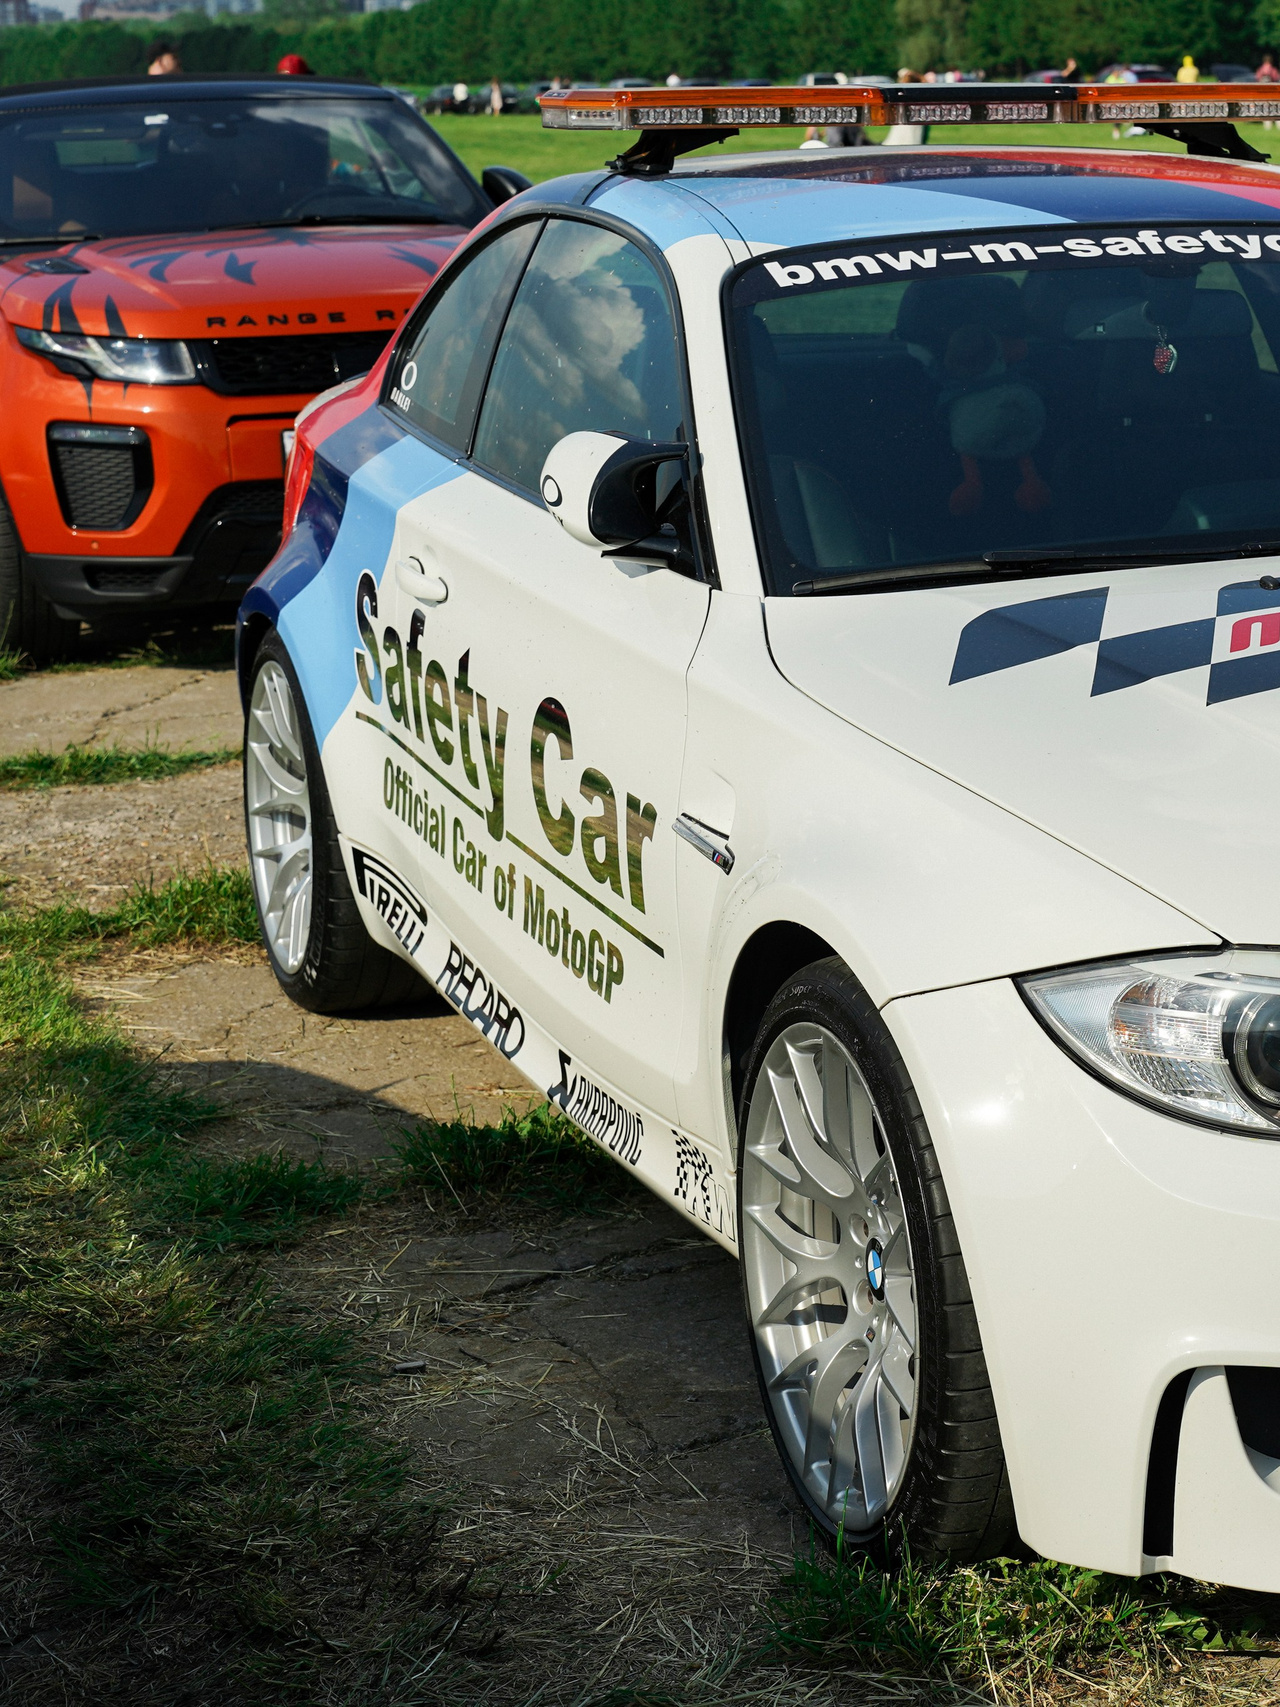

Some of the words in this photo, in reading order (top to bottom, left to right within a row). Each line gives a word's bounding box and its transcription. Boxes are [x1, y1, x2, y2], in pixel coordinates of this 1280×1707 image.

[206, 311, 346, 328] RANGE
[354, 570, 509, 842] Safety
[530, 696, 658, 915] Car
[352, 845, 428, 957] PIRELLI
[383, 756, 446, 859] Official
[453, 815, 487, 895] Car
[493, 862, 517, 921] of
[523, 873, 624, 1005] MotoGP
[435, 939, 526, 1061] RECARO
